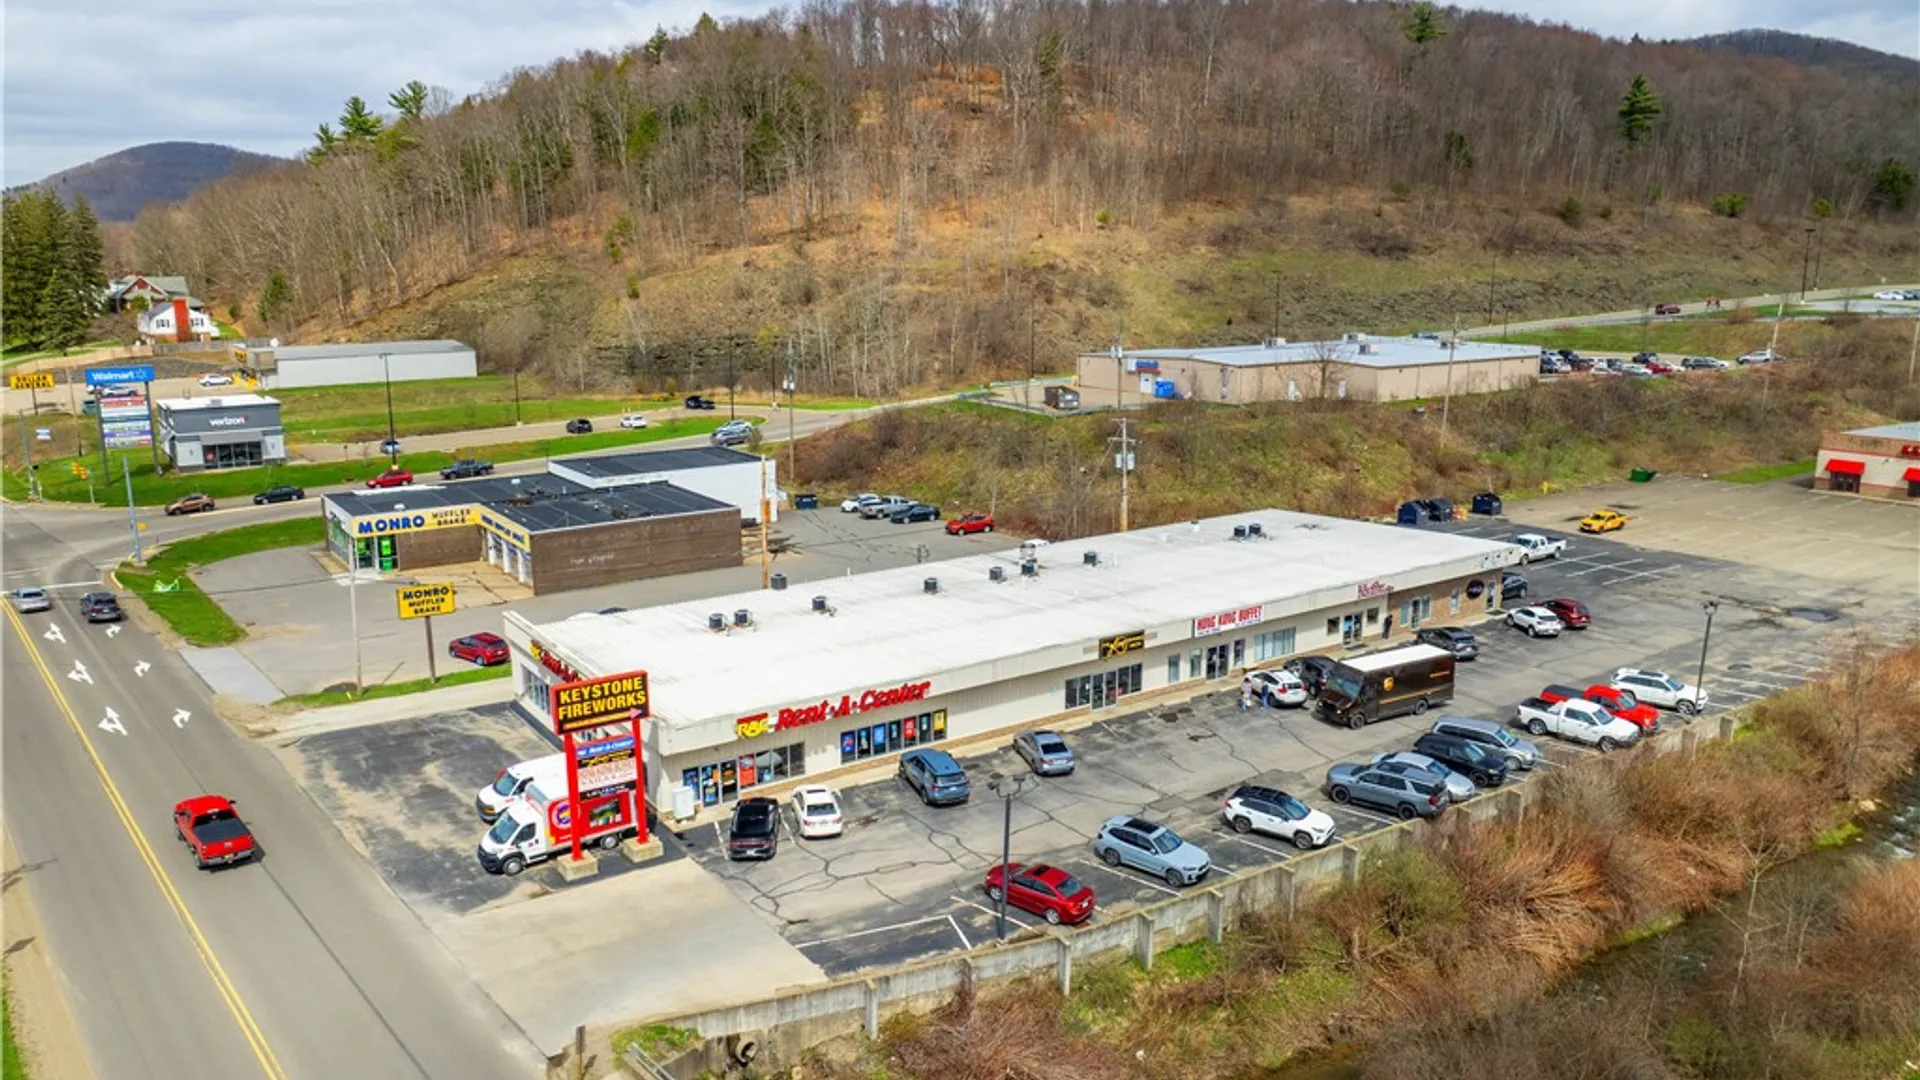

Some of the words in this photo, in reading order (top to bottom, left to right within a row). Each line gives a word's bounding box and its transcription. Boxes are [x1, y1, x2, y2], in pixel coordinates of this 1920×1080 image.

[91, 371, 134, 381] Walmart
[209, 416, 245, 427] verizon
[432, 508, 470, 519] MUFFLER
[358, 515, 425, 534] MONRO
[437, 517, 466, 526] BRAKE
[403, 586, 449, 600] MONRO
[408, 597, 445, 607] MUFFLER
[413, 605, 441, 614] BRAKE
[560, 676, 643, 704] KEYSTONE
[558, 691, 646, 720] FIREWORKS
